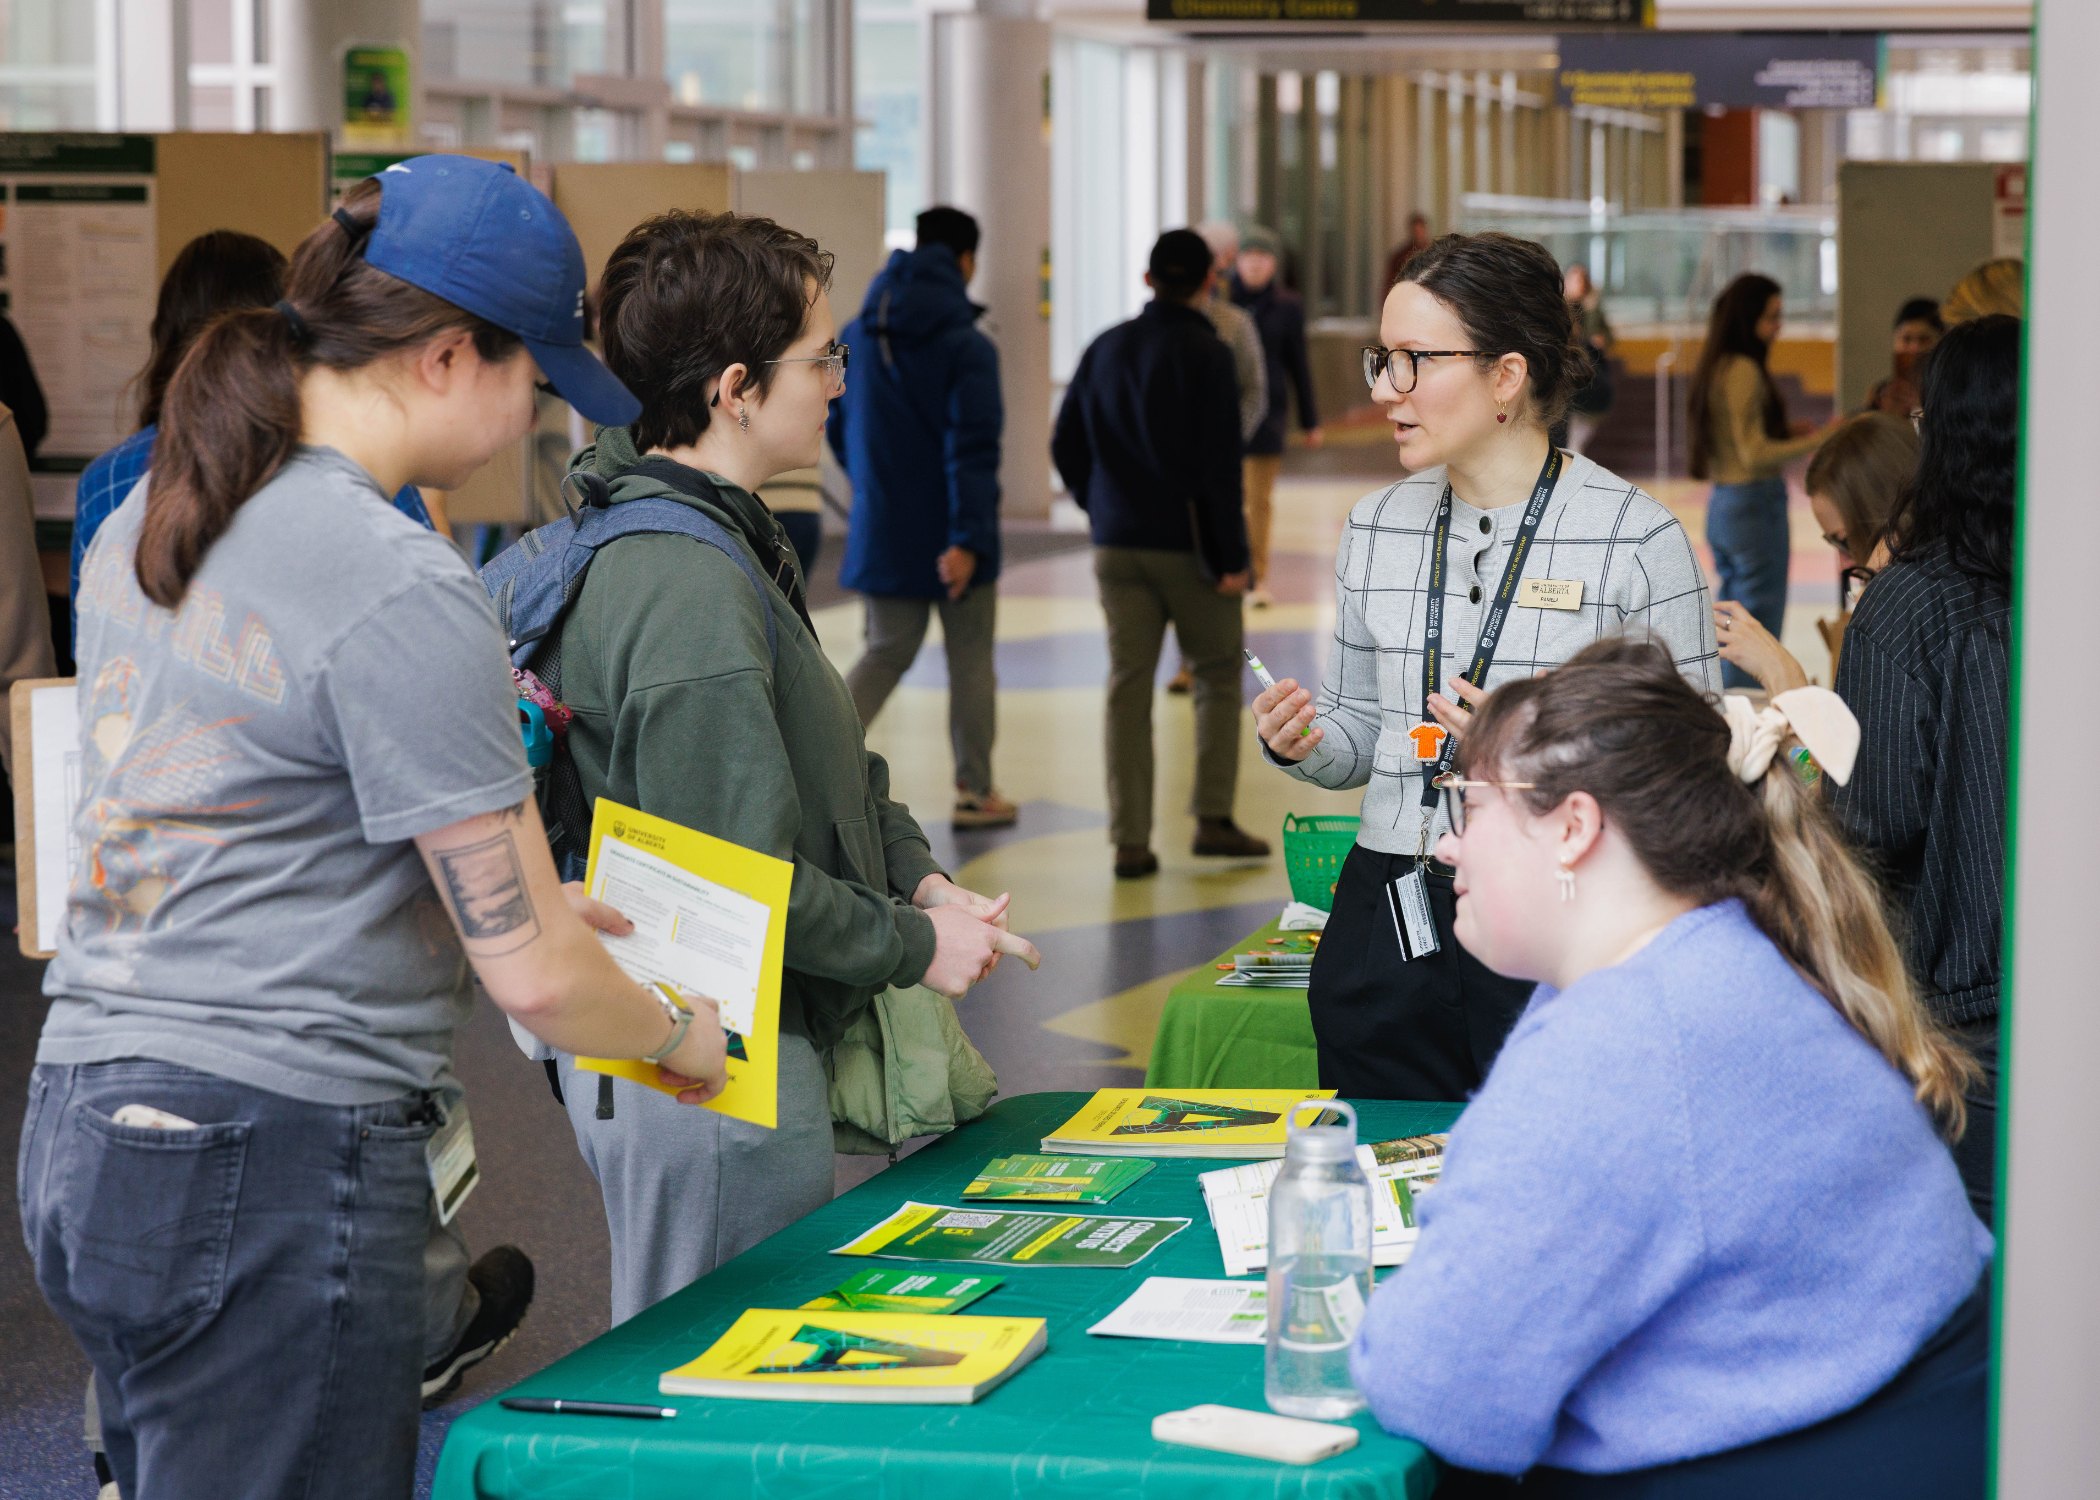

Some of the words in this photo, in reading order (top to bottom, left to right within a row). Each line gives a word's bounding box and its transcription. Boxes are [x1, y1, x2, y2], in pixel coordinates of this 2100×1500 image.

[1530, 486, 1544, 515] UNIVERSITY
[1537, 488, 1548, 509] ALBERTA
[1502, 582, 1512, 598] OFFICE
[1539, 587, 1570, 595] ALBERTA
[1486, 607, 1498, 636] UNIVERSITY
[628, 827, 666, 842] UNIVERSITY
[637, 838, 665, 850] ALBERTA
[1100, 1222, 1156, 1253] CONNECT
